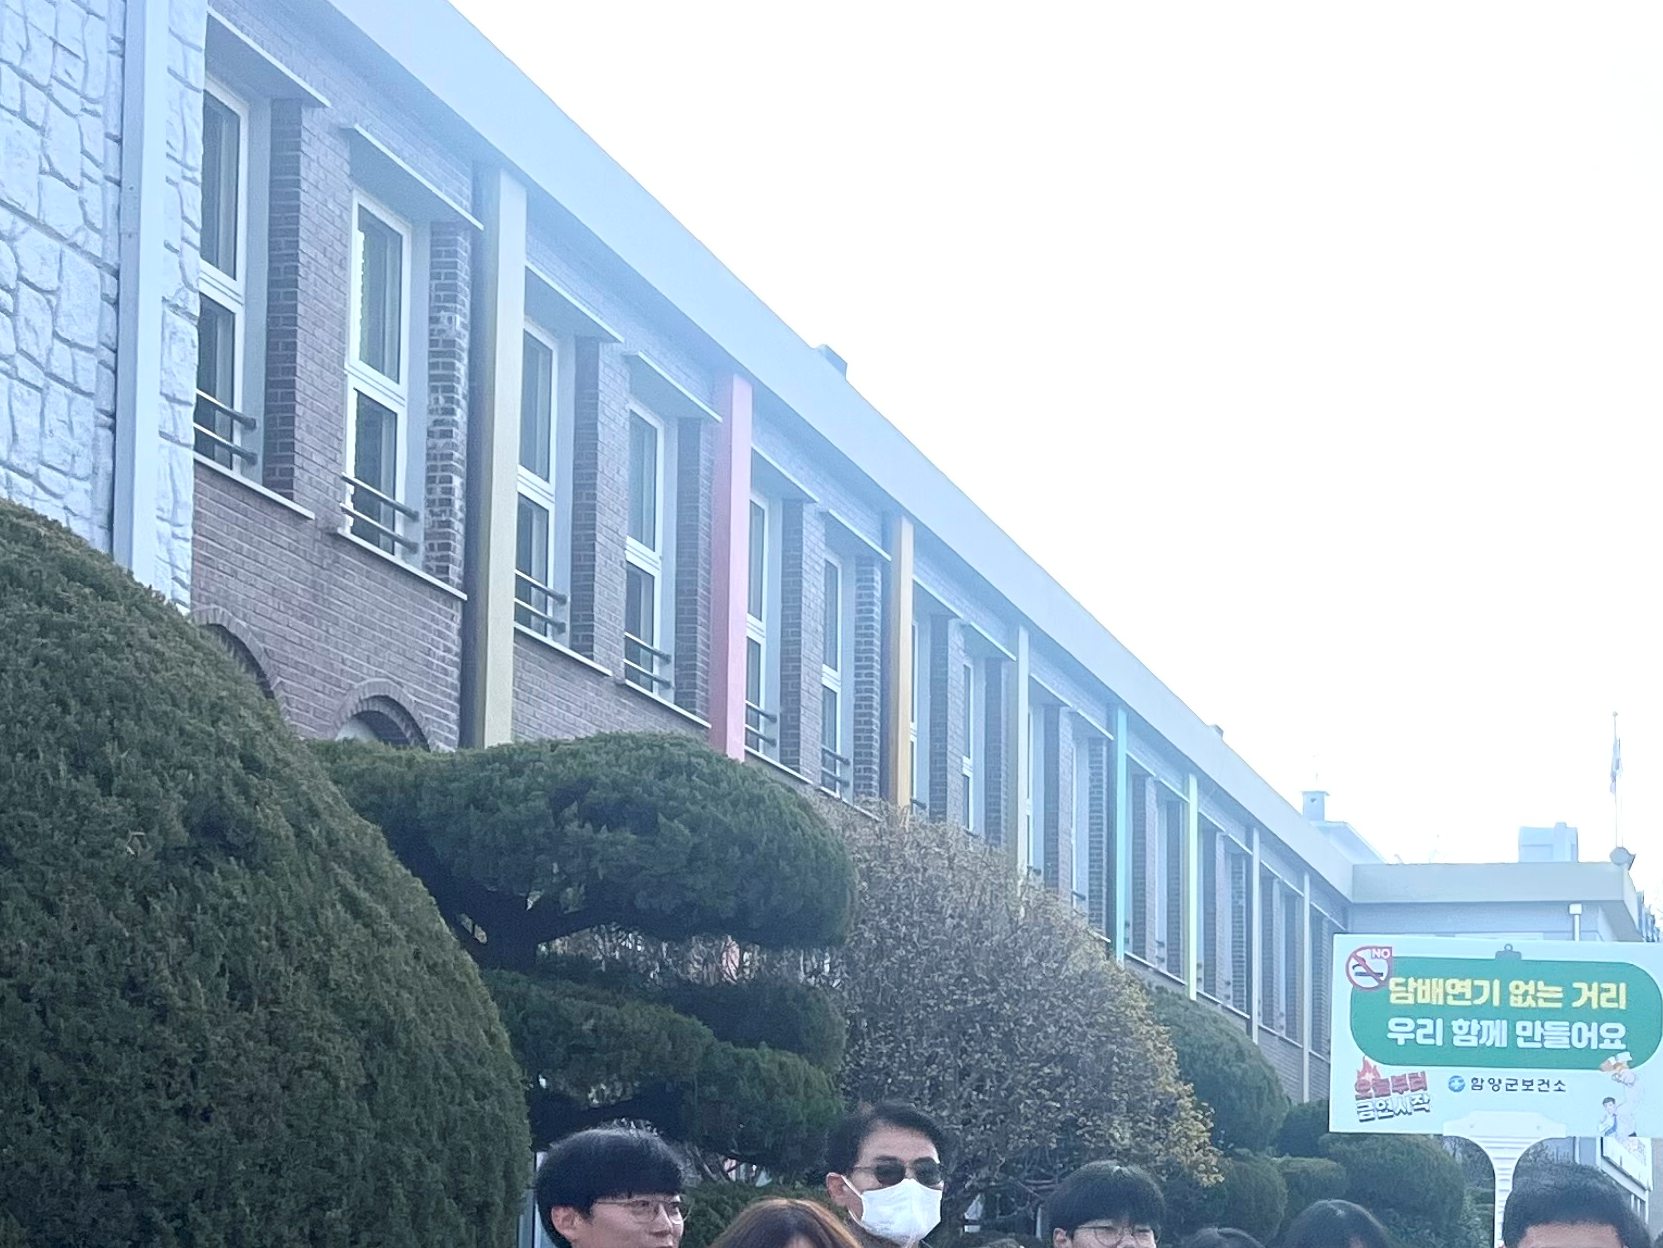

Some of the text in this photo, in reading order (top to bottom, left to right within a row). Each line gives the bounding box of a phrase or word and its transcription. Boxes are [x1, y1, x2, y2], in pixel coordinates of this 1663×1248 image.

[1371, 948, 1390, 959] NO
[1388, 977, 1627, 1010] 담배연기 없는 거리
[1387, 1017, 1627, 1050] 우리 함께 만들어요
[1470, 1076, 1567, 1093] 함양군보건소
